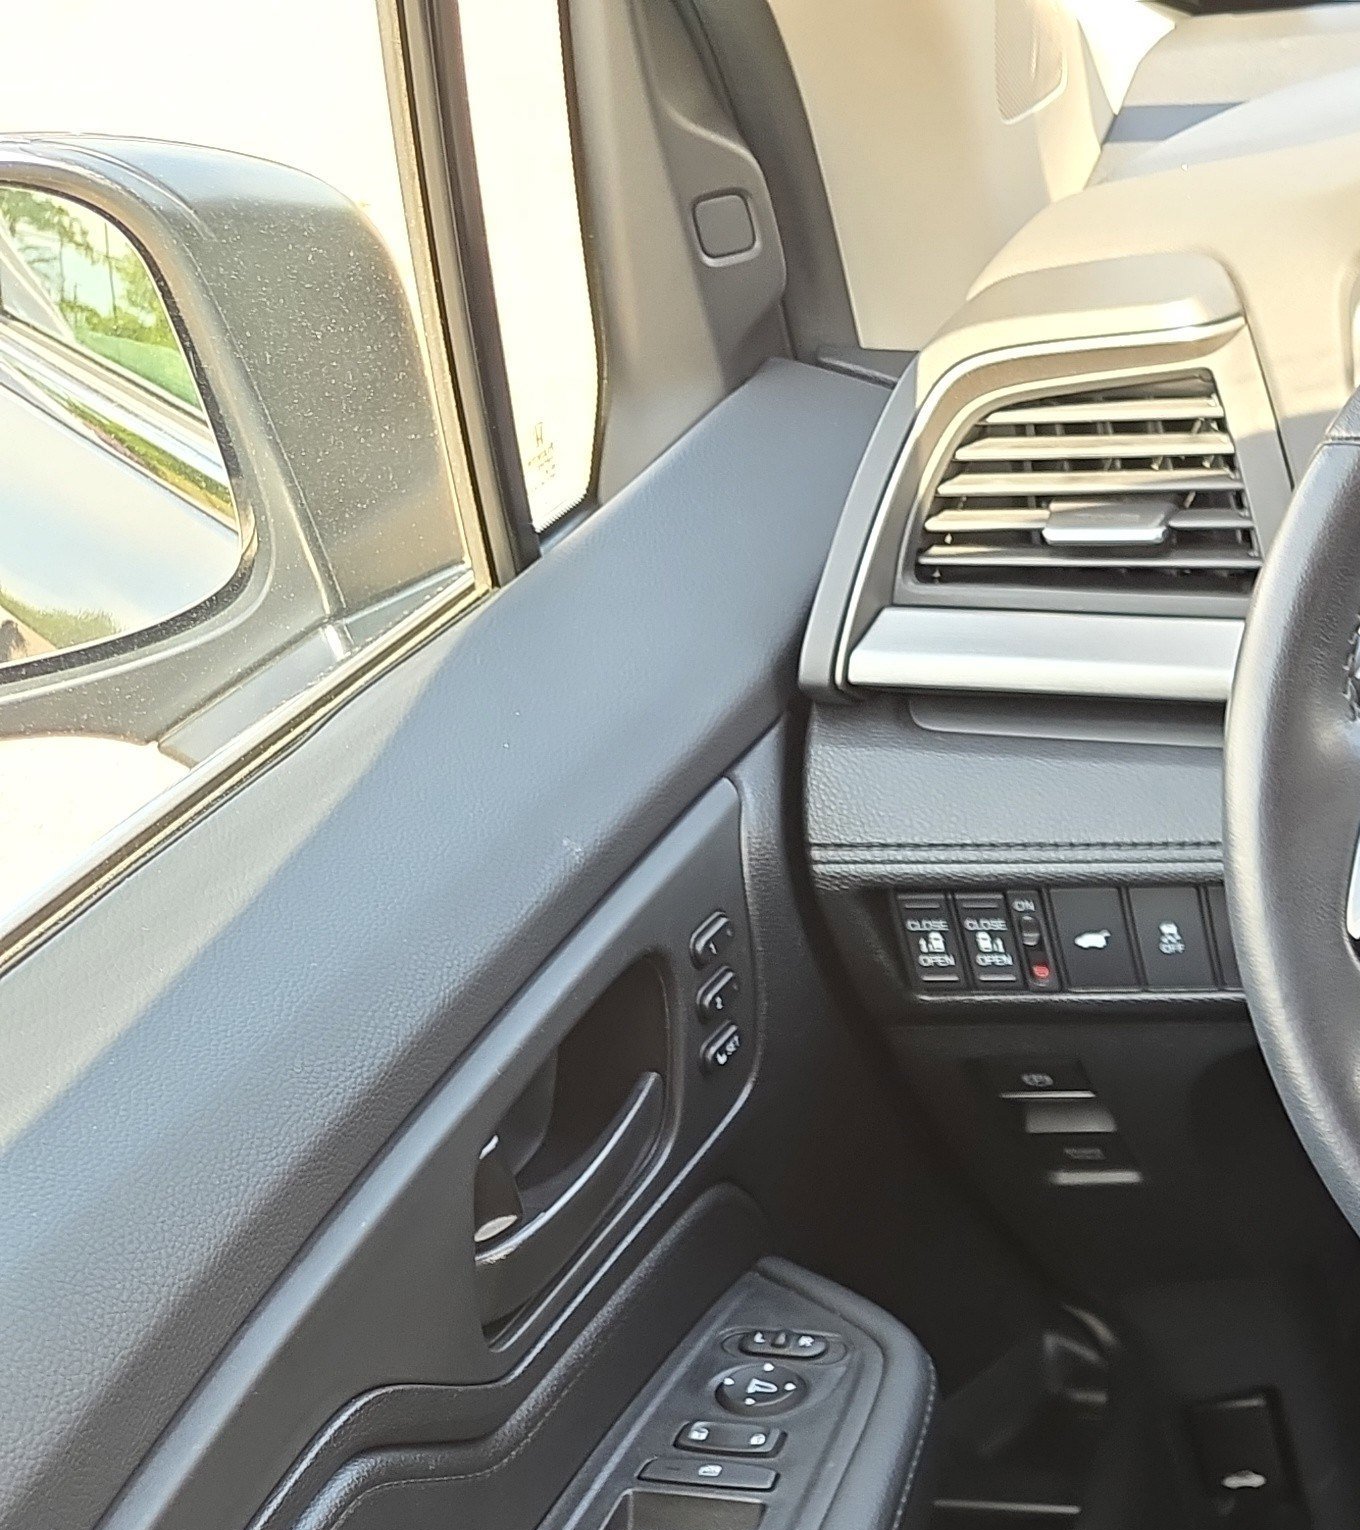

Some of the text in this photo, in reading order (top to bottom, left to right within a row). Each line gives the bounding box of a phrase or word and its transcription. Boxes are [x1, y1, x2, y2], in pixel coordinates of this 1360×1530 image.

[1012, 899, 1036, 913] ON
[906, 918, 950, 932] CLOSE
[963, 918, 1008, 932] CLOSE
[918, 953, 956, 967] OPEN
[975, 953, 1014, 967] OPEN
